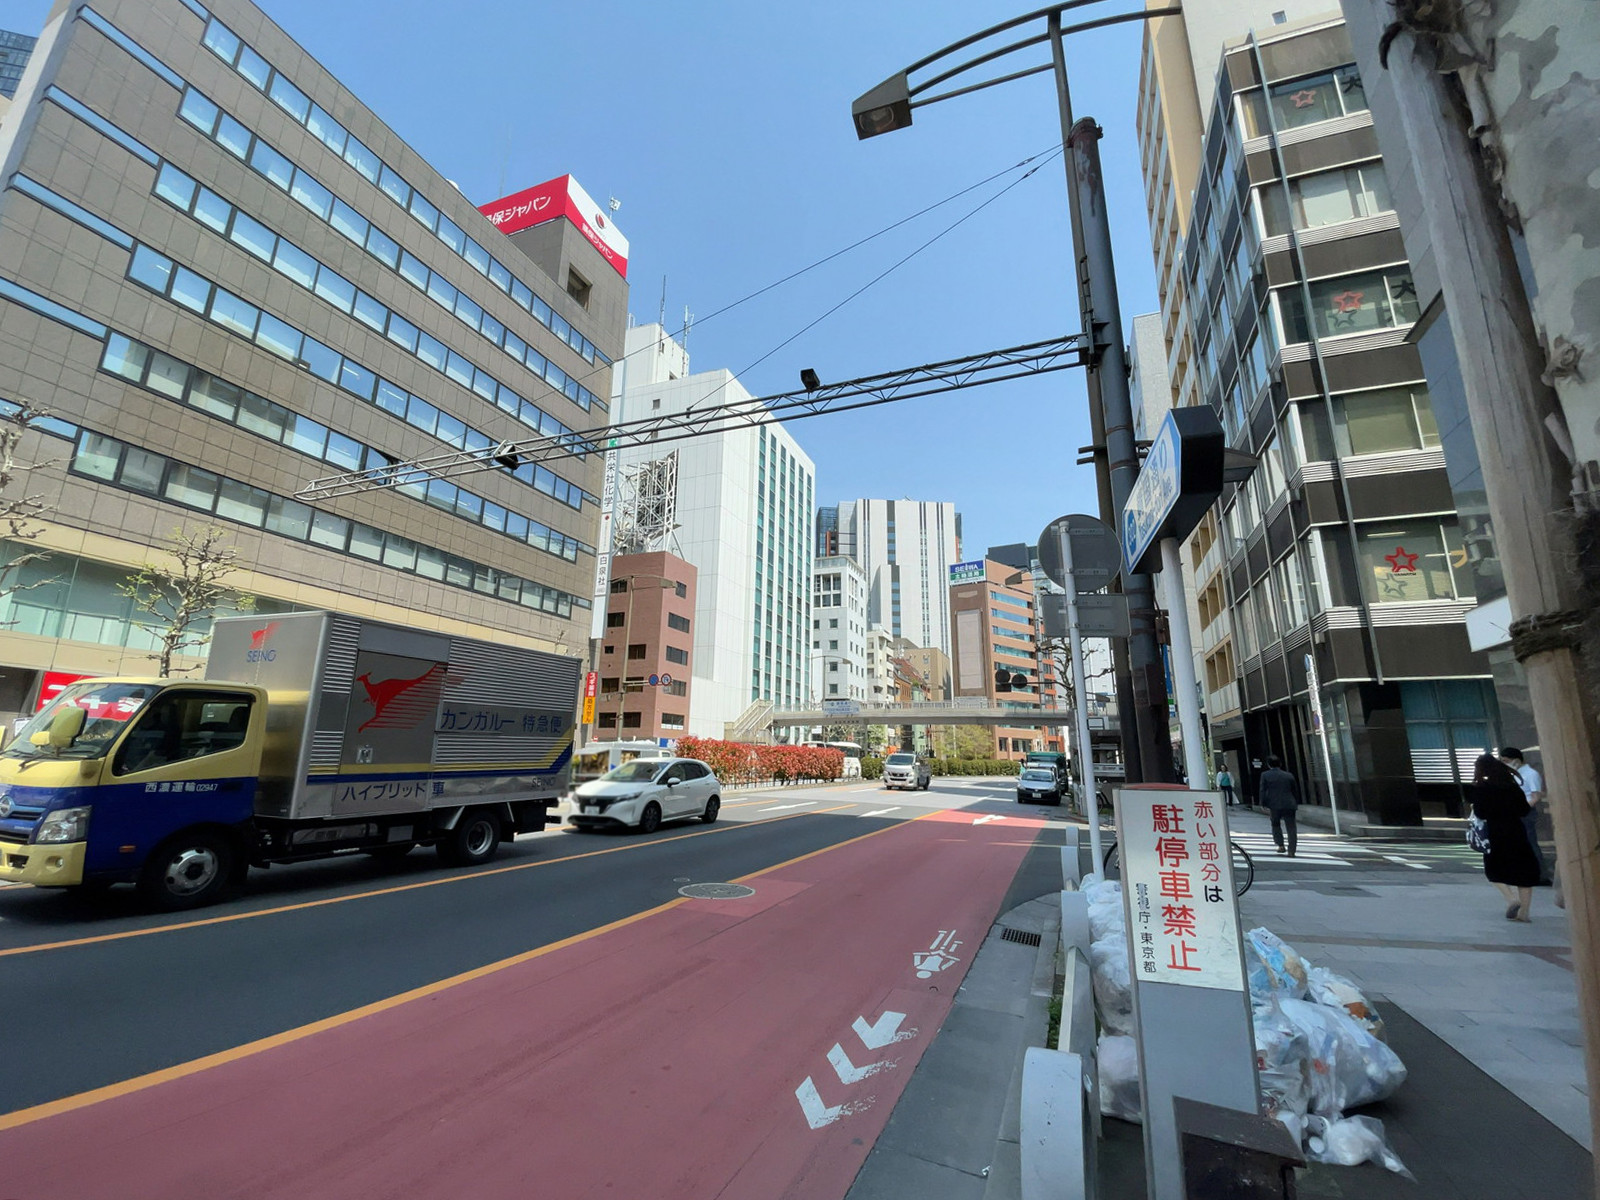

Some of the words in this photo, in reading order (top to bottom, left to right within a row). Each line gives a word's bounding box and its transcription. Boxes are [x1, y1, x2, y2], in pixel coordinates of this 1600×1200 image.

[604, 451, 616, 507] 共栄社化学
[247, 649, 277, 663] SEINO
[440, 709, 515, 731] カンガルー
[522, 714, 563, 733] 特急便
[1193, 800, 1224, 903] 赤い部分は
[1152, 804, 1202, 972] 駐停車禁止
